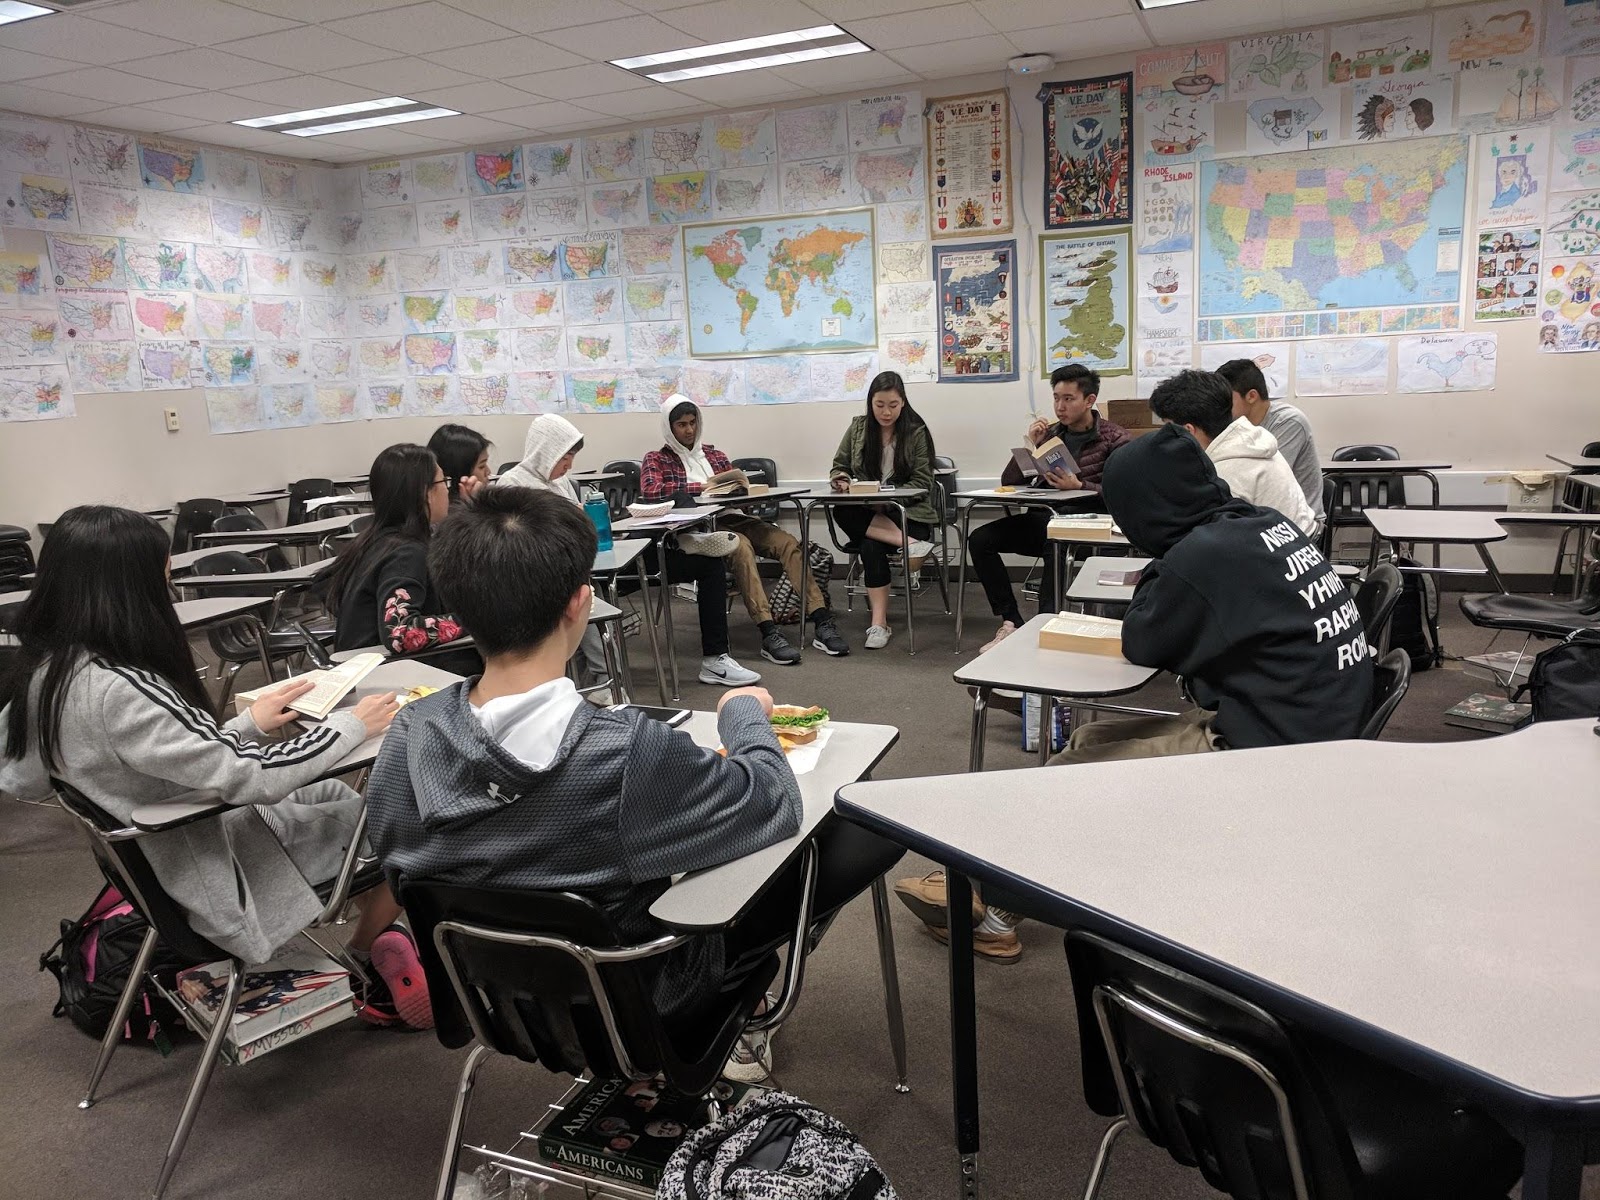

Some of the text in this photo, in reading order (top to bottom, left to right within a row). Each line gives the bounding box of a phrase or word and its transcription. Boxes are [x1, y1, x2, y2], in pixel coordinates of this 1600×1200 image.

[1241, 32, 1315, 48] VIRGINIA
[968, 104, 985, 115] DAY
[1086, 92, 1105, 104] DAY
[1144, 167, 1169, 177] RHODE
[1162, 171, 1193, 182] ISLAND
[1284, 543, 1325, 582] JIREH
[1298, 568, 1346, 611] YHWH
[1313, 598, 1361, 644] RAPHA
[562, 1075, 623, 1137] AMERICA
[556, 1145, 644, 1181] AMERICANS
